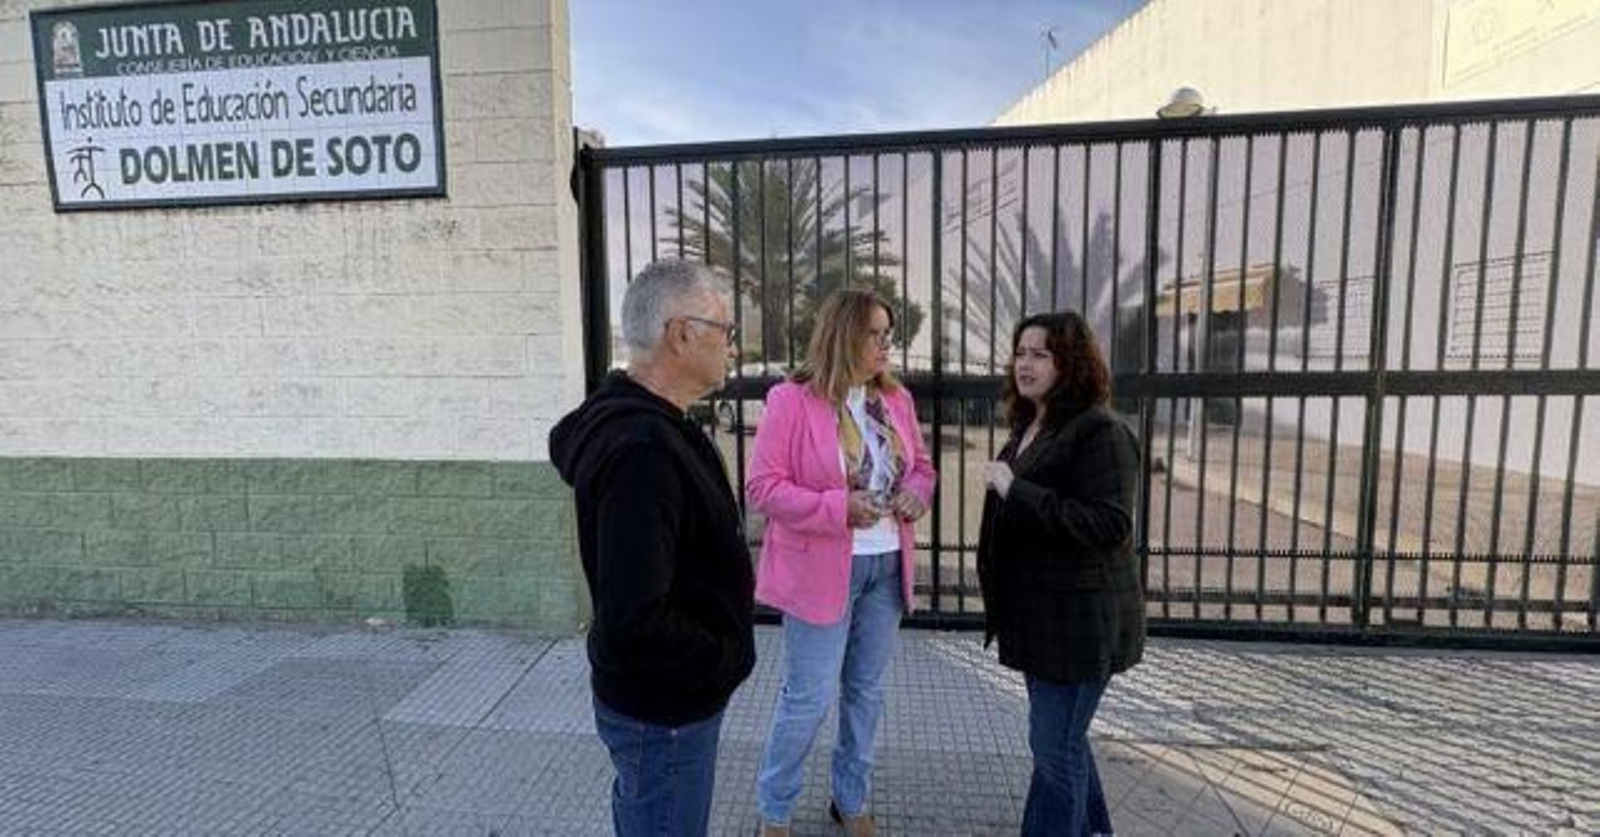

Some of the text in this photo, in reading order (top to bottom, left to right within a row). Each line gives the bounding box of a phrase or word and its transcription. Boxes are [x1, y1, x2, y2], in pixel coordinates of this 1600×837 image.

[96, 23, 185, 58] JUNTA
[197, 18, 234, 51] DE
[205, 55, 224, 69] DE
[337, 45, 399, 62] CIENCIA
[59, 72, 417, 130] Instituto de Educación Secundaria
[119, 132, 421, 184] DOLMEN DE SOTO
